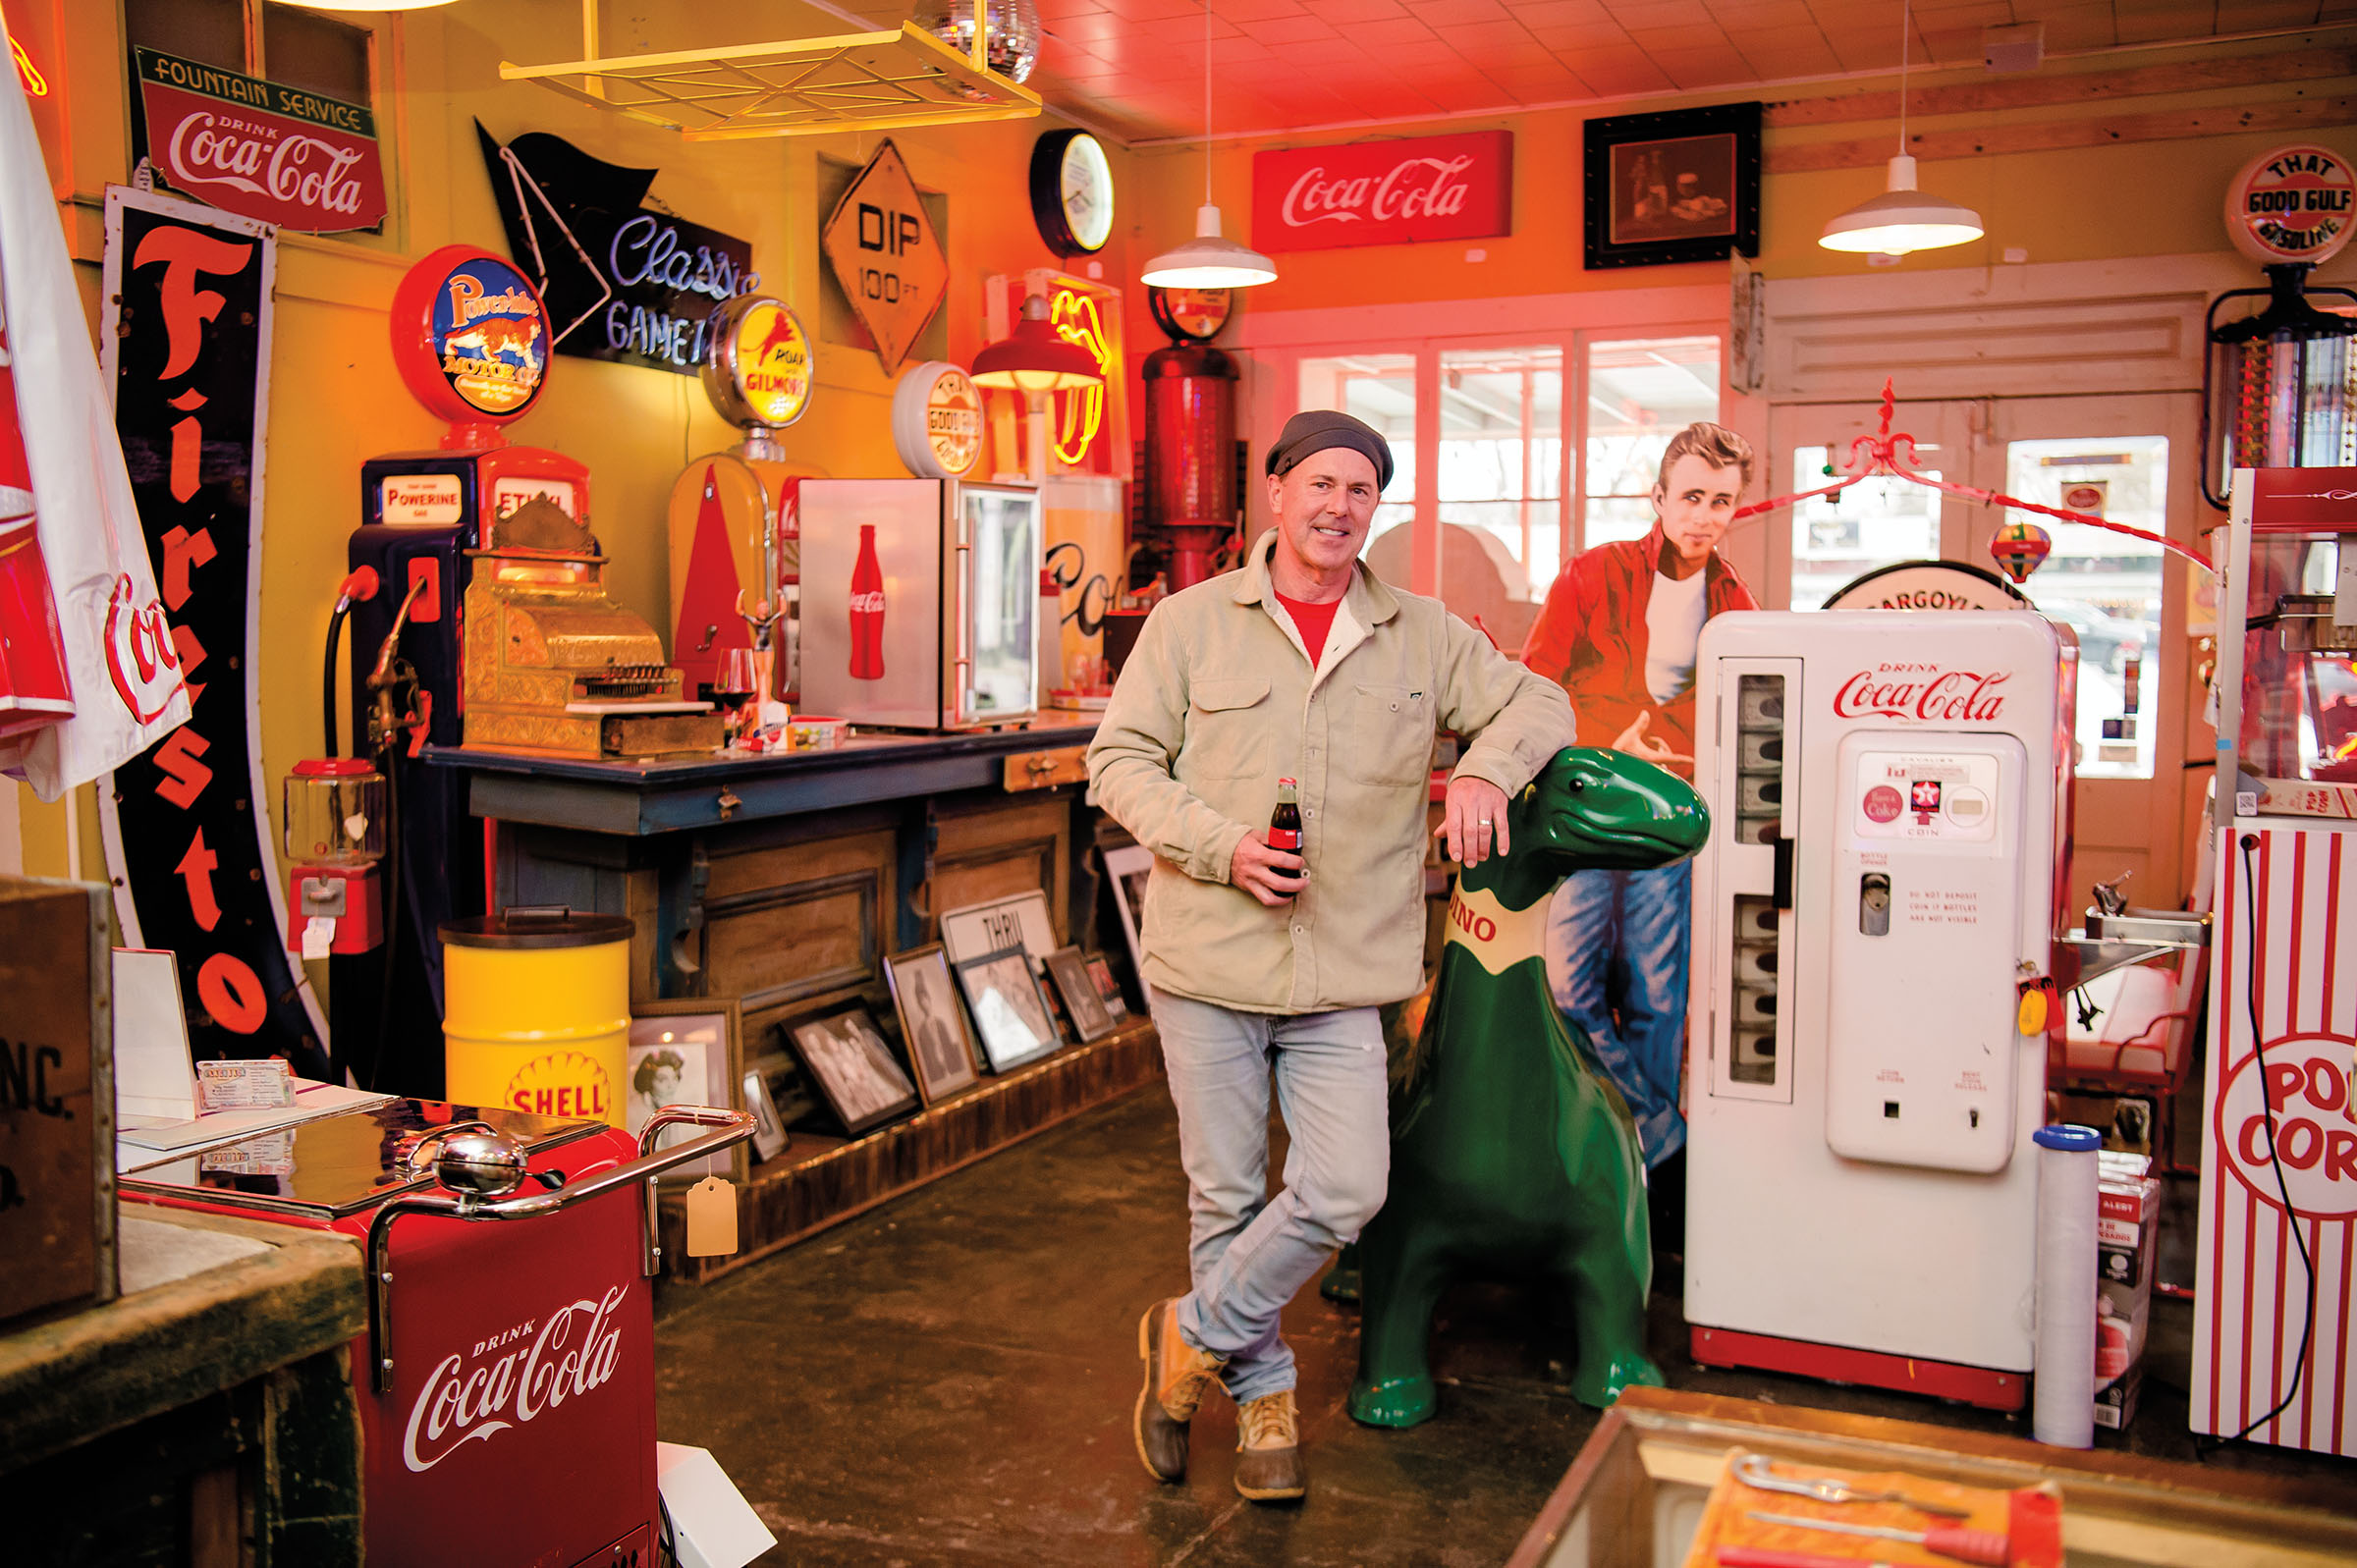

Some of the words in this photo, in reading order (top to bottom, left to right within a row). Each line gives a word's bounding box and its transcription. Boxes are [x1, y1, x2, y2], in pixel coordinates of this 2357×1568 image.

[154, 57, 270, 107] FOUNTAIN
[279, 90, 362, 131] SERVICE
[218, 116, 280, 139] DRINK
[169, 111, 364, 214] Coca-Cola
[2267, 154, 2335, 178] THAT
[1282, 154, 1476, 227] Coca-Cola
[2248, 189, 2300, 213] GOOD
[2305, 189, 2351, 211] GULF
[858, 202, 920, 257] DIP
[2258, 217, 2339, 250] GASOLINE
[859, 267, 900, 303] 100
[442, 355, 516, 381] MOTOR
[1878, 662, 1941, 673] DRINK
[1834, 671, 2012, 721] Coca-Cola
[1907, 828, 1940, 837] COIN
[1450, 894, 1496, 942] INO
[514, 1083, 604, 1117] SHELL
[471, 1318, 537, 1359] DRINK
[403, 1279, 630, 1473] Coca-Cola
